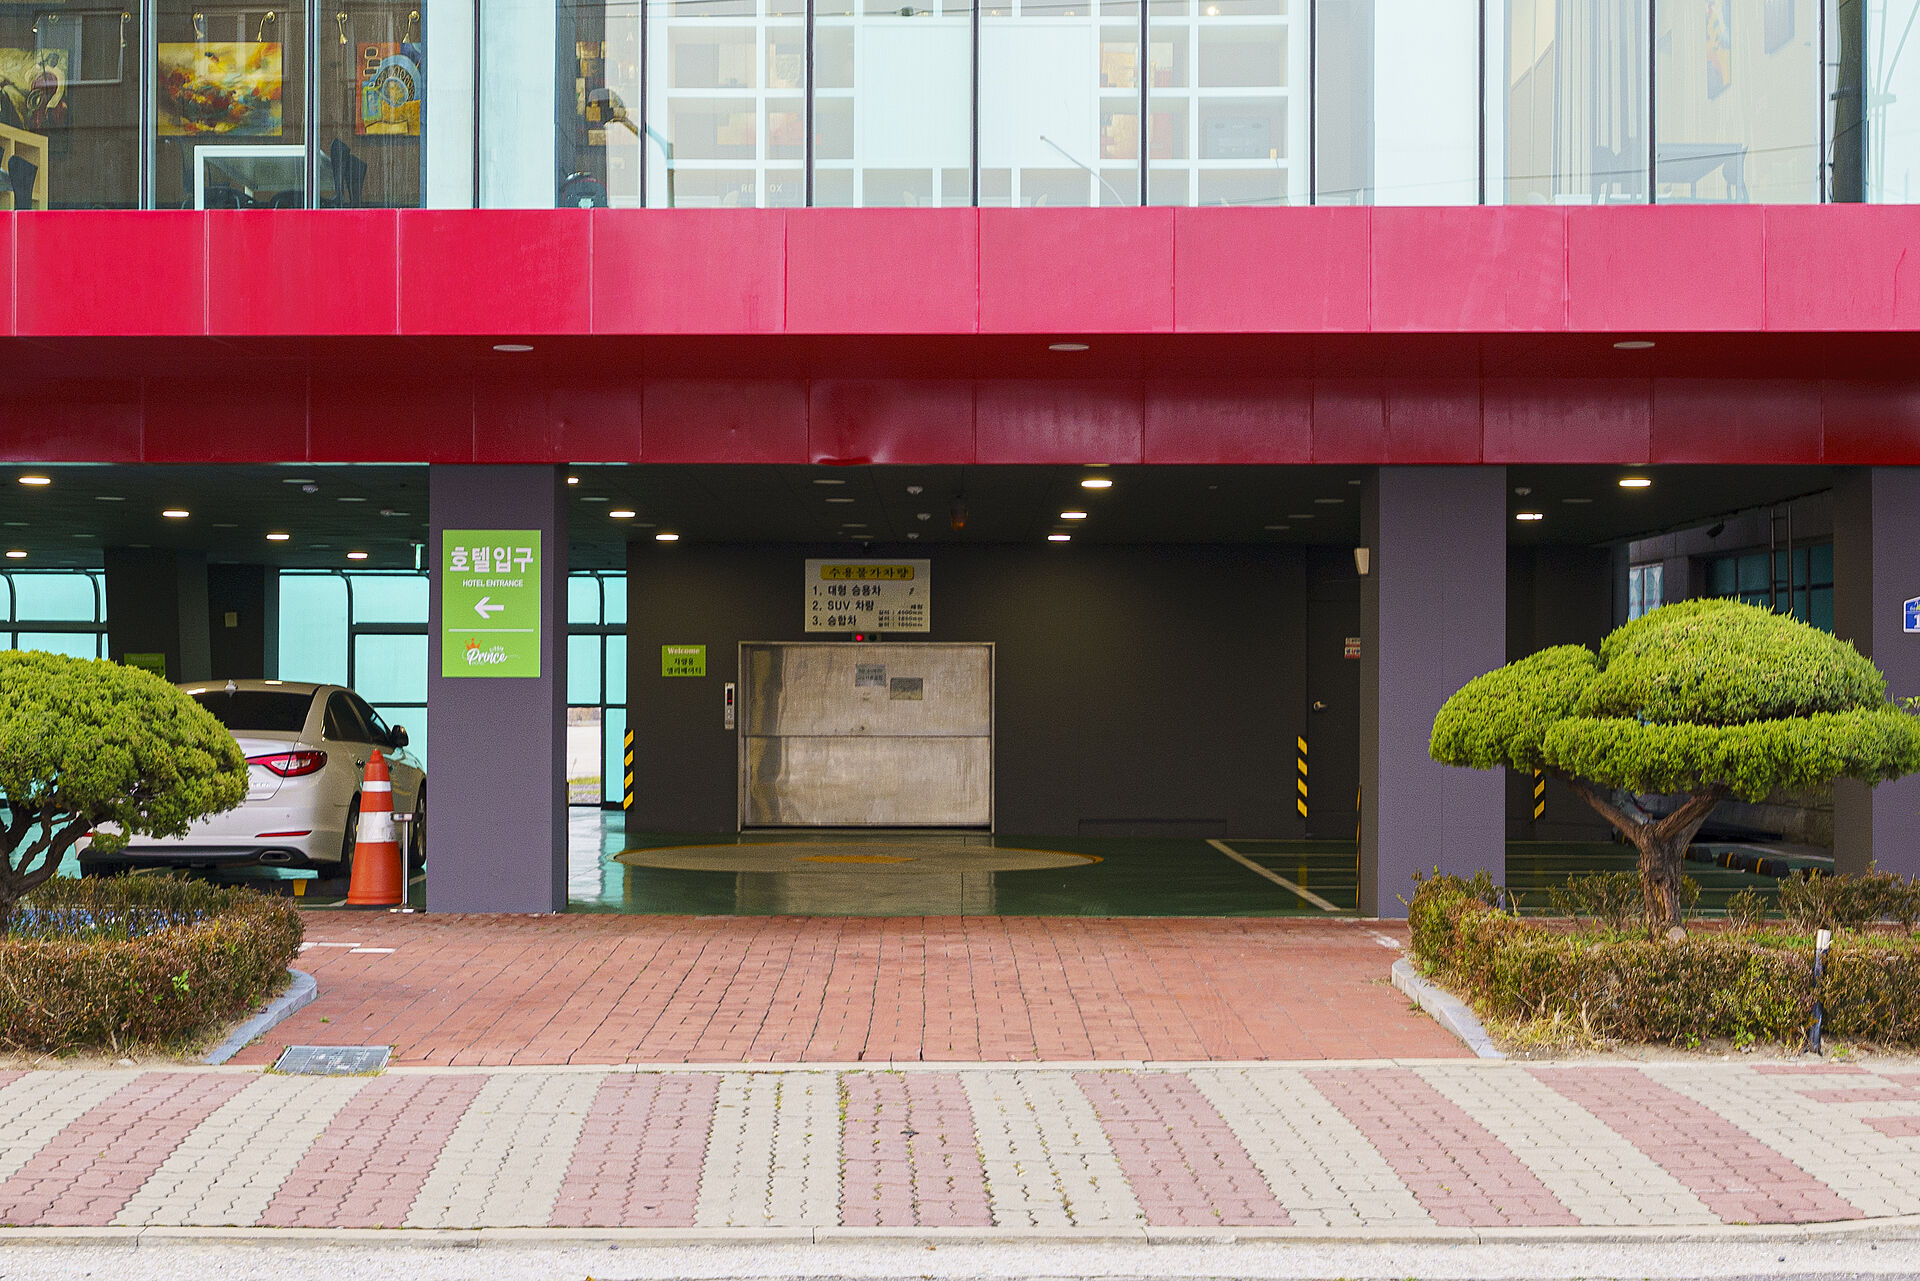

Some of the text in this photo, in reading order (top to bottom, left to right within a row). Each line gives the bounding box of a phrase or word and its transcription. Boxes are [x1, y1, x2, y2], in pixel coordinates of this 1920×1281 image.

[449, 546, 534, 573] 호텔입구
[462, 580, 523, 588] HOTEL ENTRANCE
[812, 585, 881, 597] 1. 대형 승용차
[812, 600, 875, 612] 2. SUV 차량
[812, 614, 857, 627] 3. 승합차
[466, 647, 508, 666] Prince
[667, 647, 701, 655] Welcome
